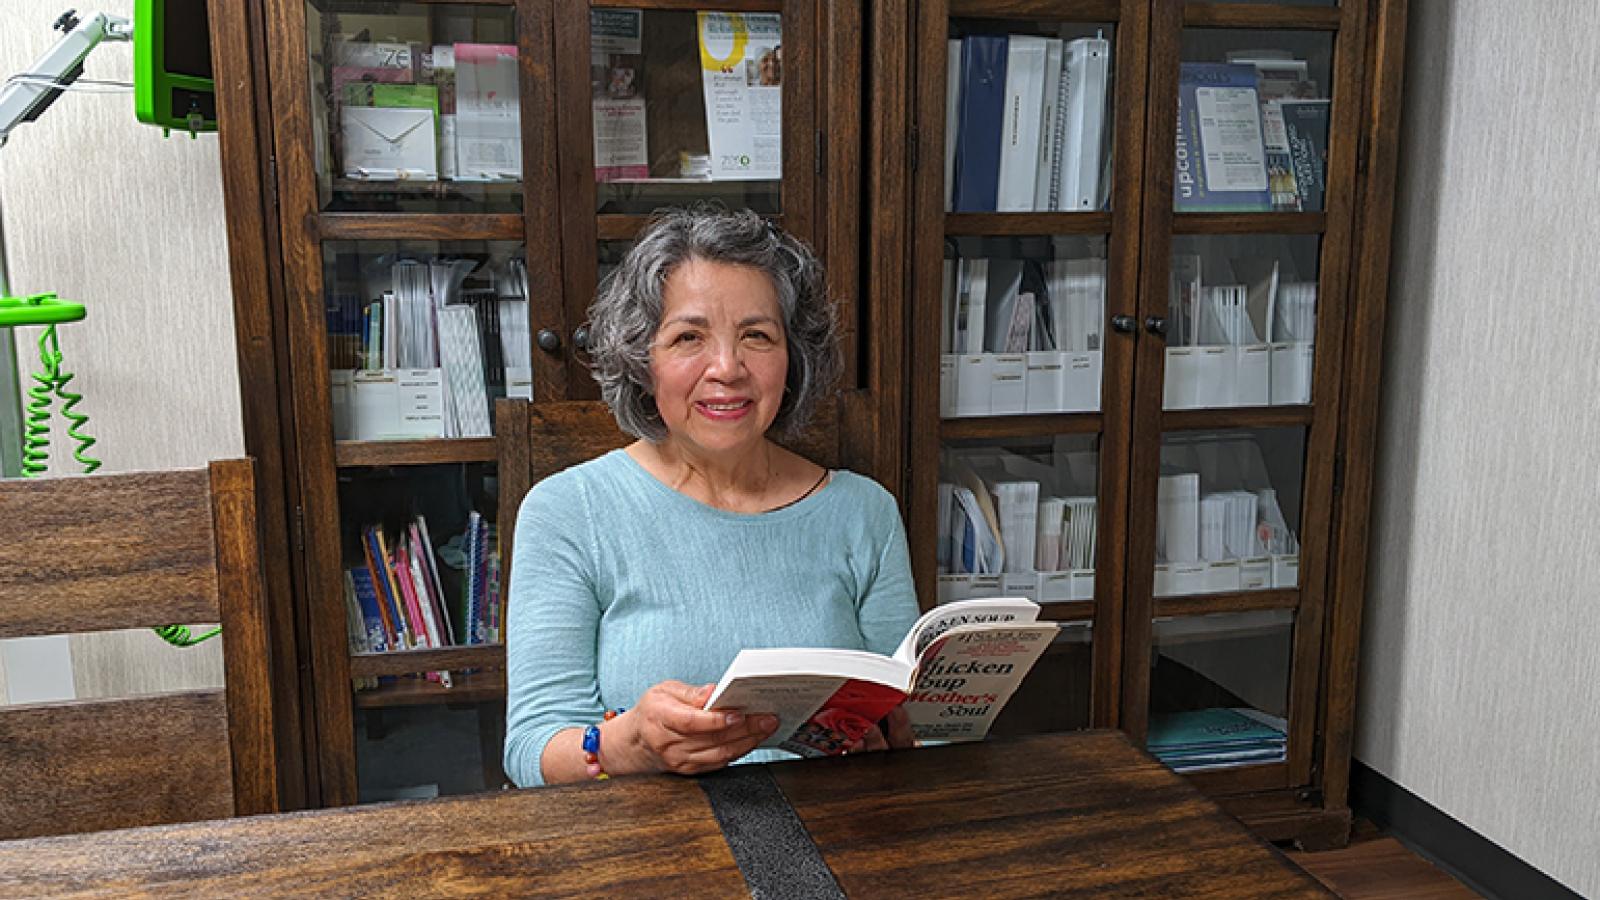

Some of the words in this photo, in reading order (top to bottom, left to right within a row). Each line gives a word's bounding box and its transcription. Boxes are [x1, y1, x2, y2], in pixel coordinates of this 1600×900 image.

[1176, 98, 1194, 198] upcom
[924, 656, 1014, 675] hicken
[918, 675, 967, 692] oup
[939, 704, 991, 718] Soul
